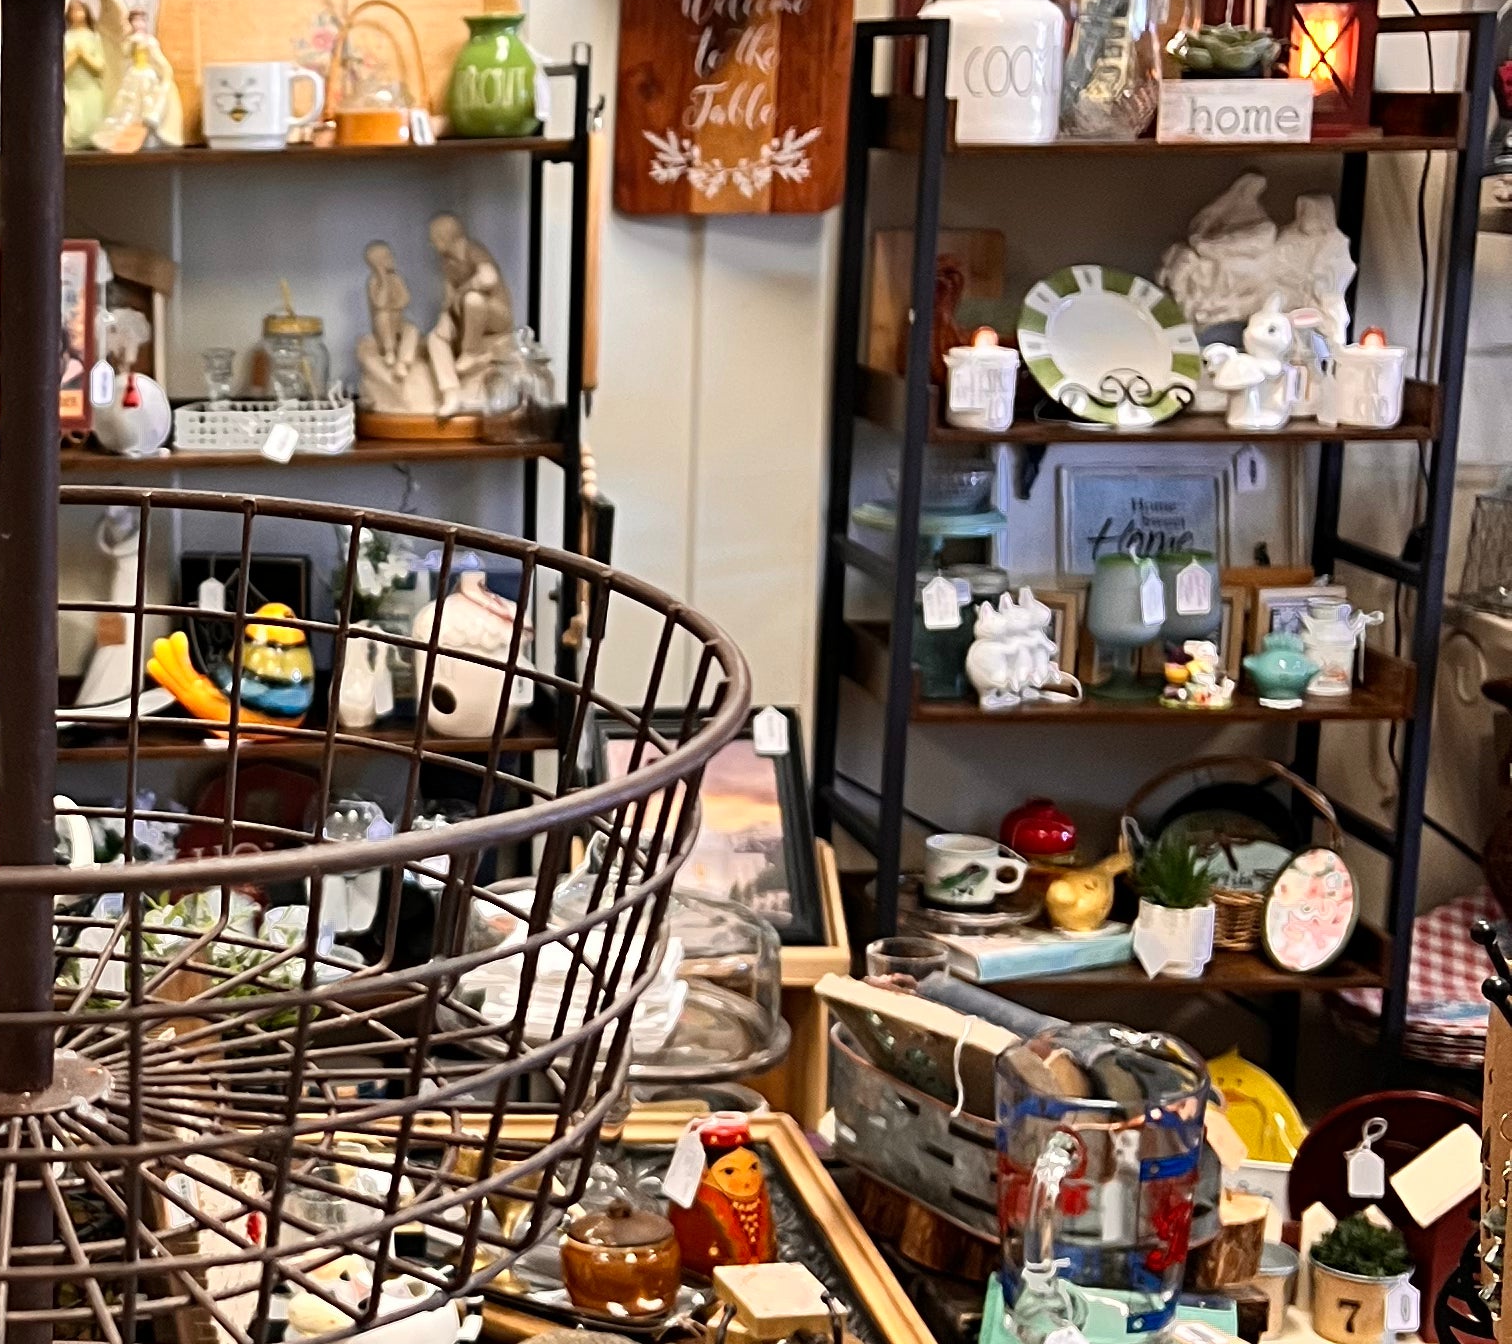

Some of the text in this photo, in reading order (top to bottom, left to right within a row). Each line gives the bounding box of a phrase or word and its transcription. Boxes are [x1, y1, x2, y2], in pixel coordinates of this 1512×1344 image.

[690, 23, 778, 78] to the
[682, 80, 779, 133] Table
[1188, 103, 1301, 135] home
[1337, 1297, 1363, 1334] 7
